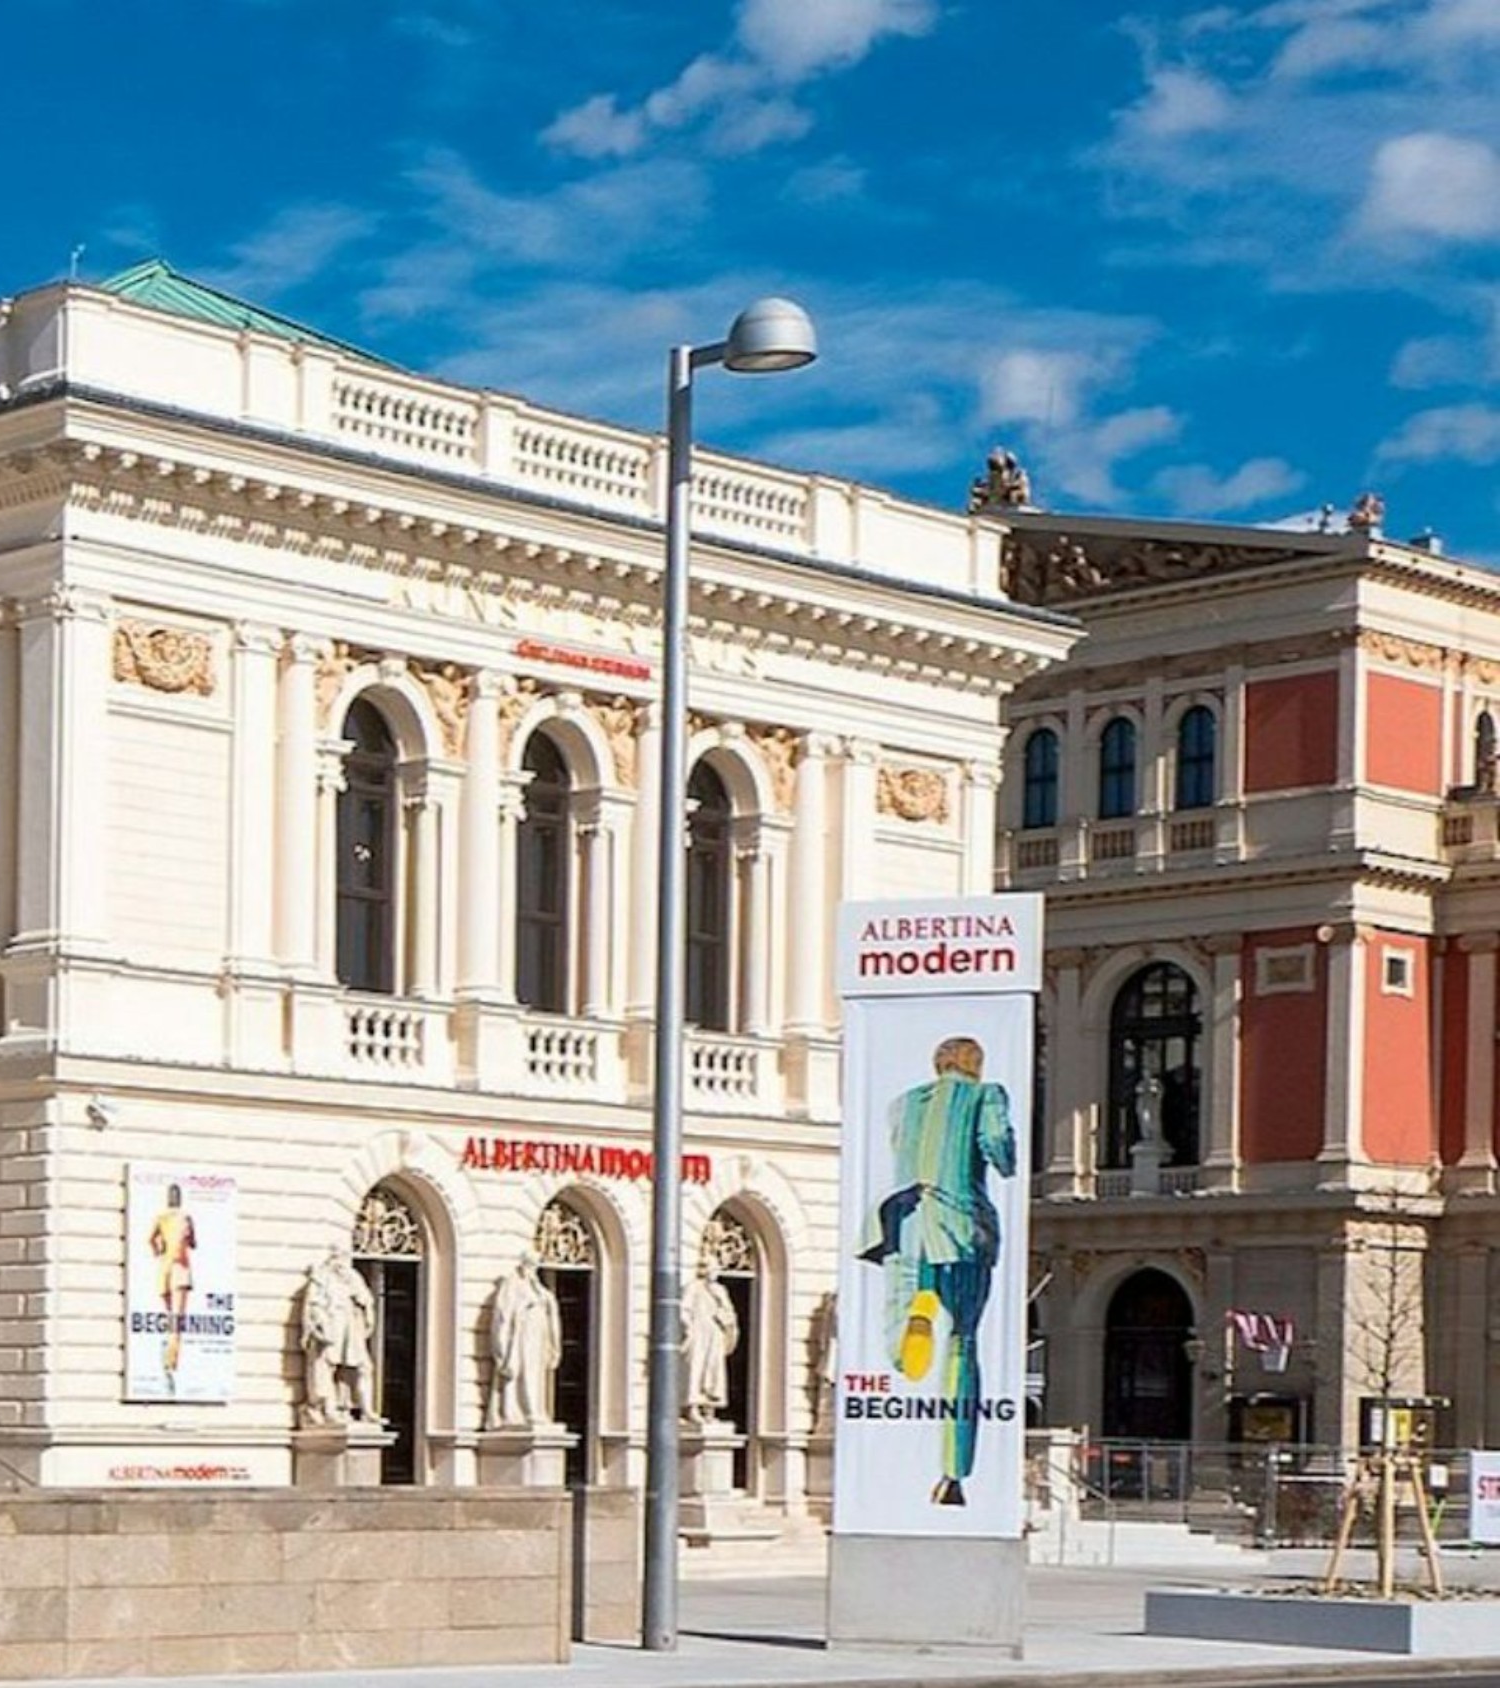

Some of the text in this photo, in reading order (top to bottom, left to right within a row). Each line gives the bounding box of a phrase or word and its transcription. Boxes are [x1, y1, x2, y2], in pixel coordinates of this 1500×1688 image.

[861, 914, 1015, 942] ALBERTINA
[859, 941, 1015, 977] modern
[205, 1293, 234, 1311] THE
[844, 1374, 891, 1392] THE
[844, 1396, 1016, 1421] BEGINNING
